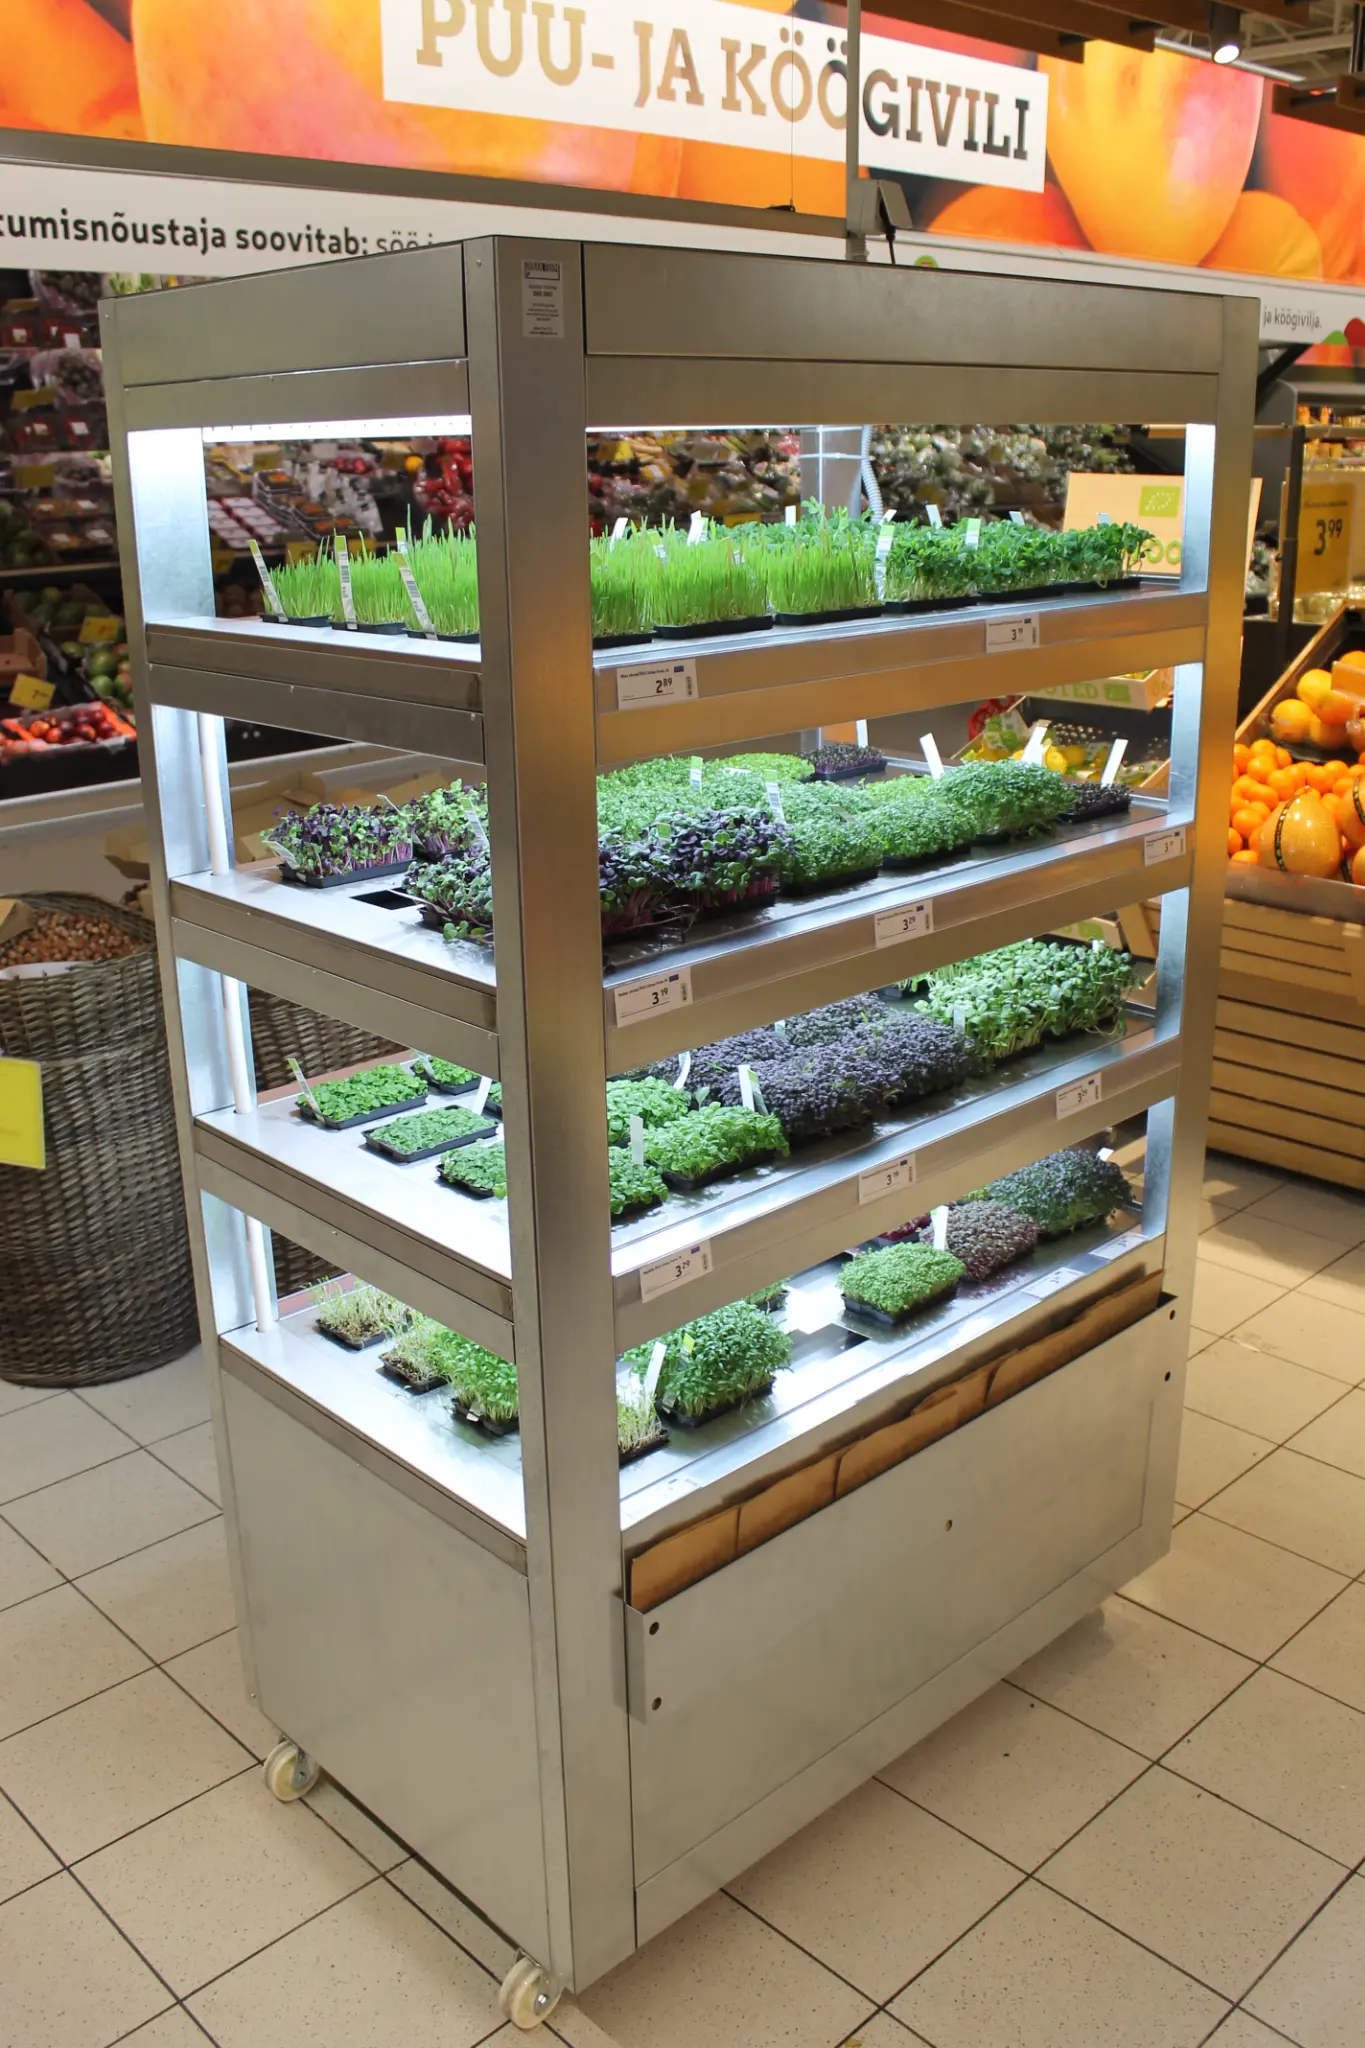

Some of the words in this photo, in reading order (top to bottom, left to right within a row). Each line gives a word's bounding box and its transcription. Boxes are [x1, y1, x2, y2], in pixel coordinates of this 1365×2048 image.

[416, 0, 614, 86] PUU-
[634, 21, 704, 108] JA
[720, 27, 1030, 160] KÖÖGIVILI
[236, 224, 368, 257] soovitab:
